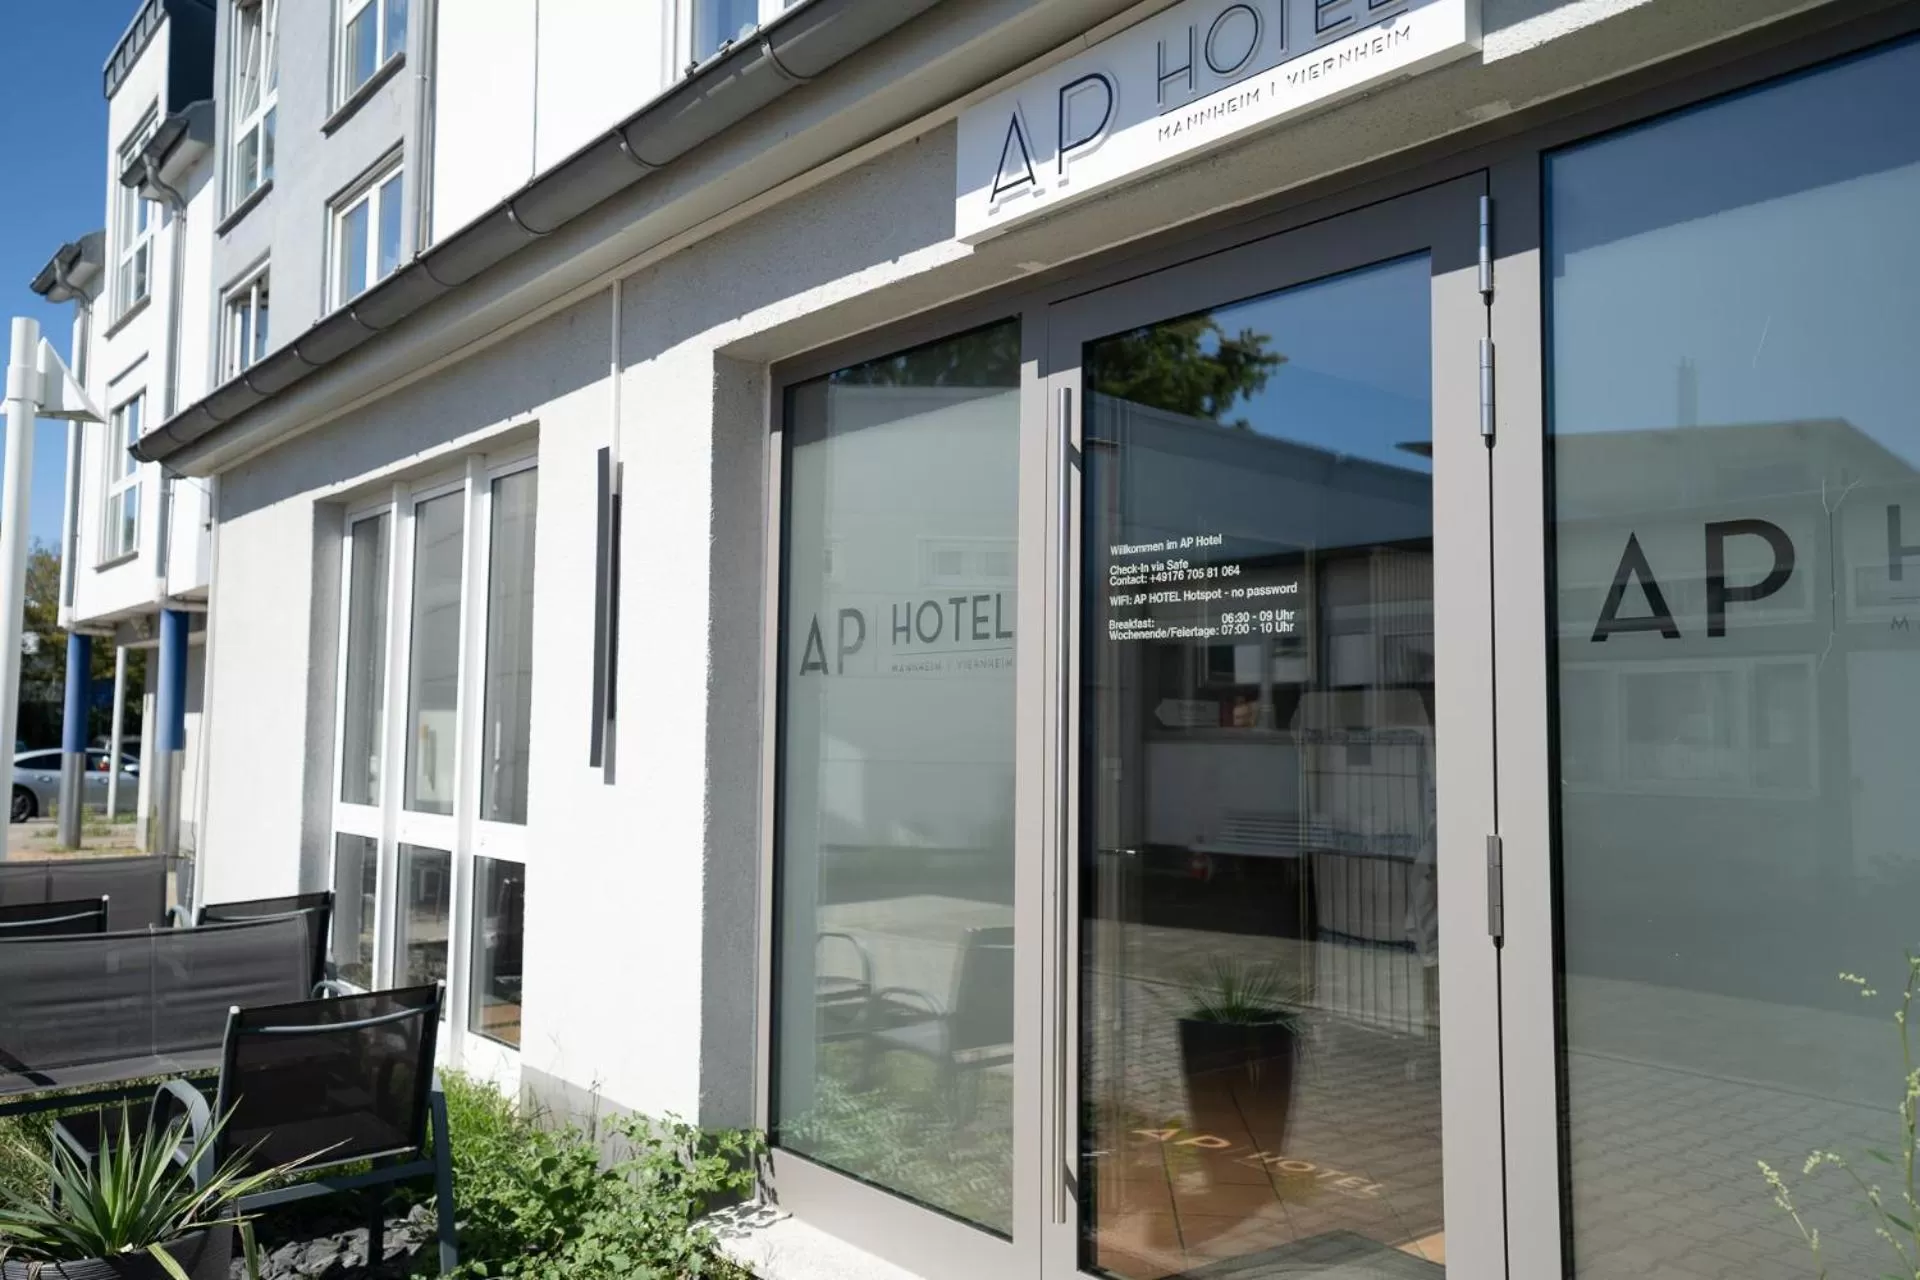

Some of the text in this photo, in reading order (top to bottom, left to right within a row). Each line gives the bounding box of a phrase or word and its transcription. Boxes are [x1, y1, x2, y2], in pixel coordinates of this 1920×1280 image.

[1157, 88, 1261, 143] MANNHEIM
[1286, 24, 1411, 86] VIERNHEIM
[990, 0, 1393, 203] AP HOTE
[1110, 533, 1222, 556] Willkommen im AP Hotel
[1109, 564, 1241, 586] Contact: +49176 705 81 064
[1150, 561, 1165, 572] via
[1166, 559, 1189, 571] Safe
[1591, 518, 1795, 642] AP
[1134, 593, 1147, 604] AP
[1149, 591, 1181, 603] HOTEL
[1183, 589, 1222, 602] Hotspot
[1231, 587, 1244, 598] no
[1246, 581, 1298, 597] password
[1109, 619, 1155, 630] Breakfast:
[1221, 611, 1250, 624] 06:30
[1259, 610, 1273, 622] 09
[1275, 609, 1295, 621] Uhr
[1221, 623, 1250, 635] 07:00
[1260, 622, 1273, 633] 10
[1275, 621, 1295, 632] Uhr
[799, 592, 1013, 676] AP HOTEL
